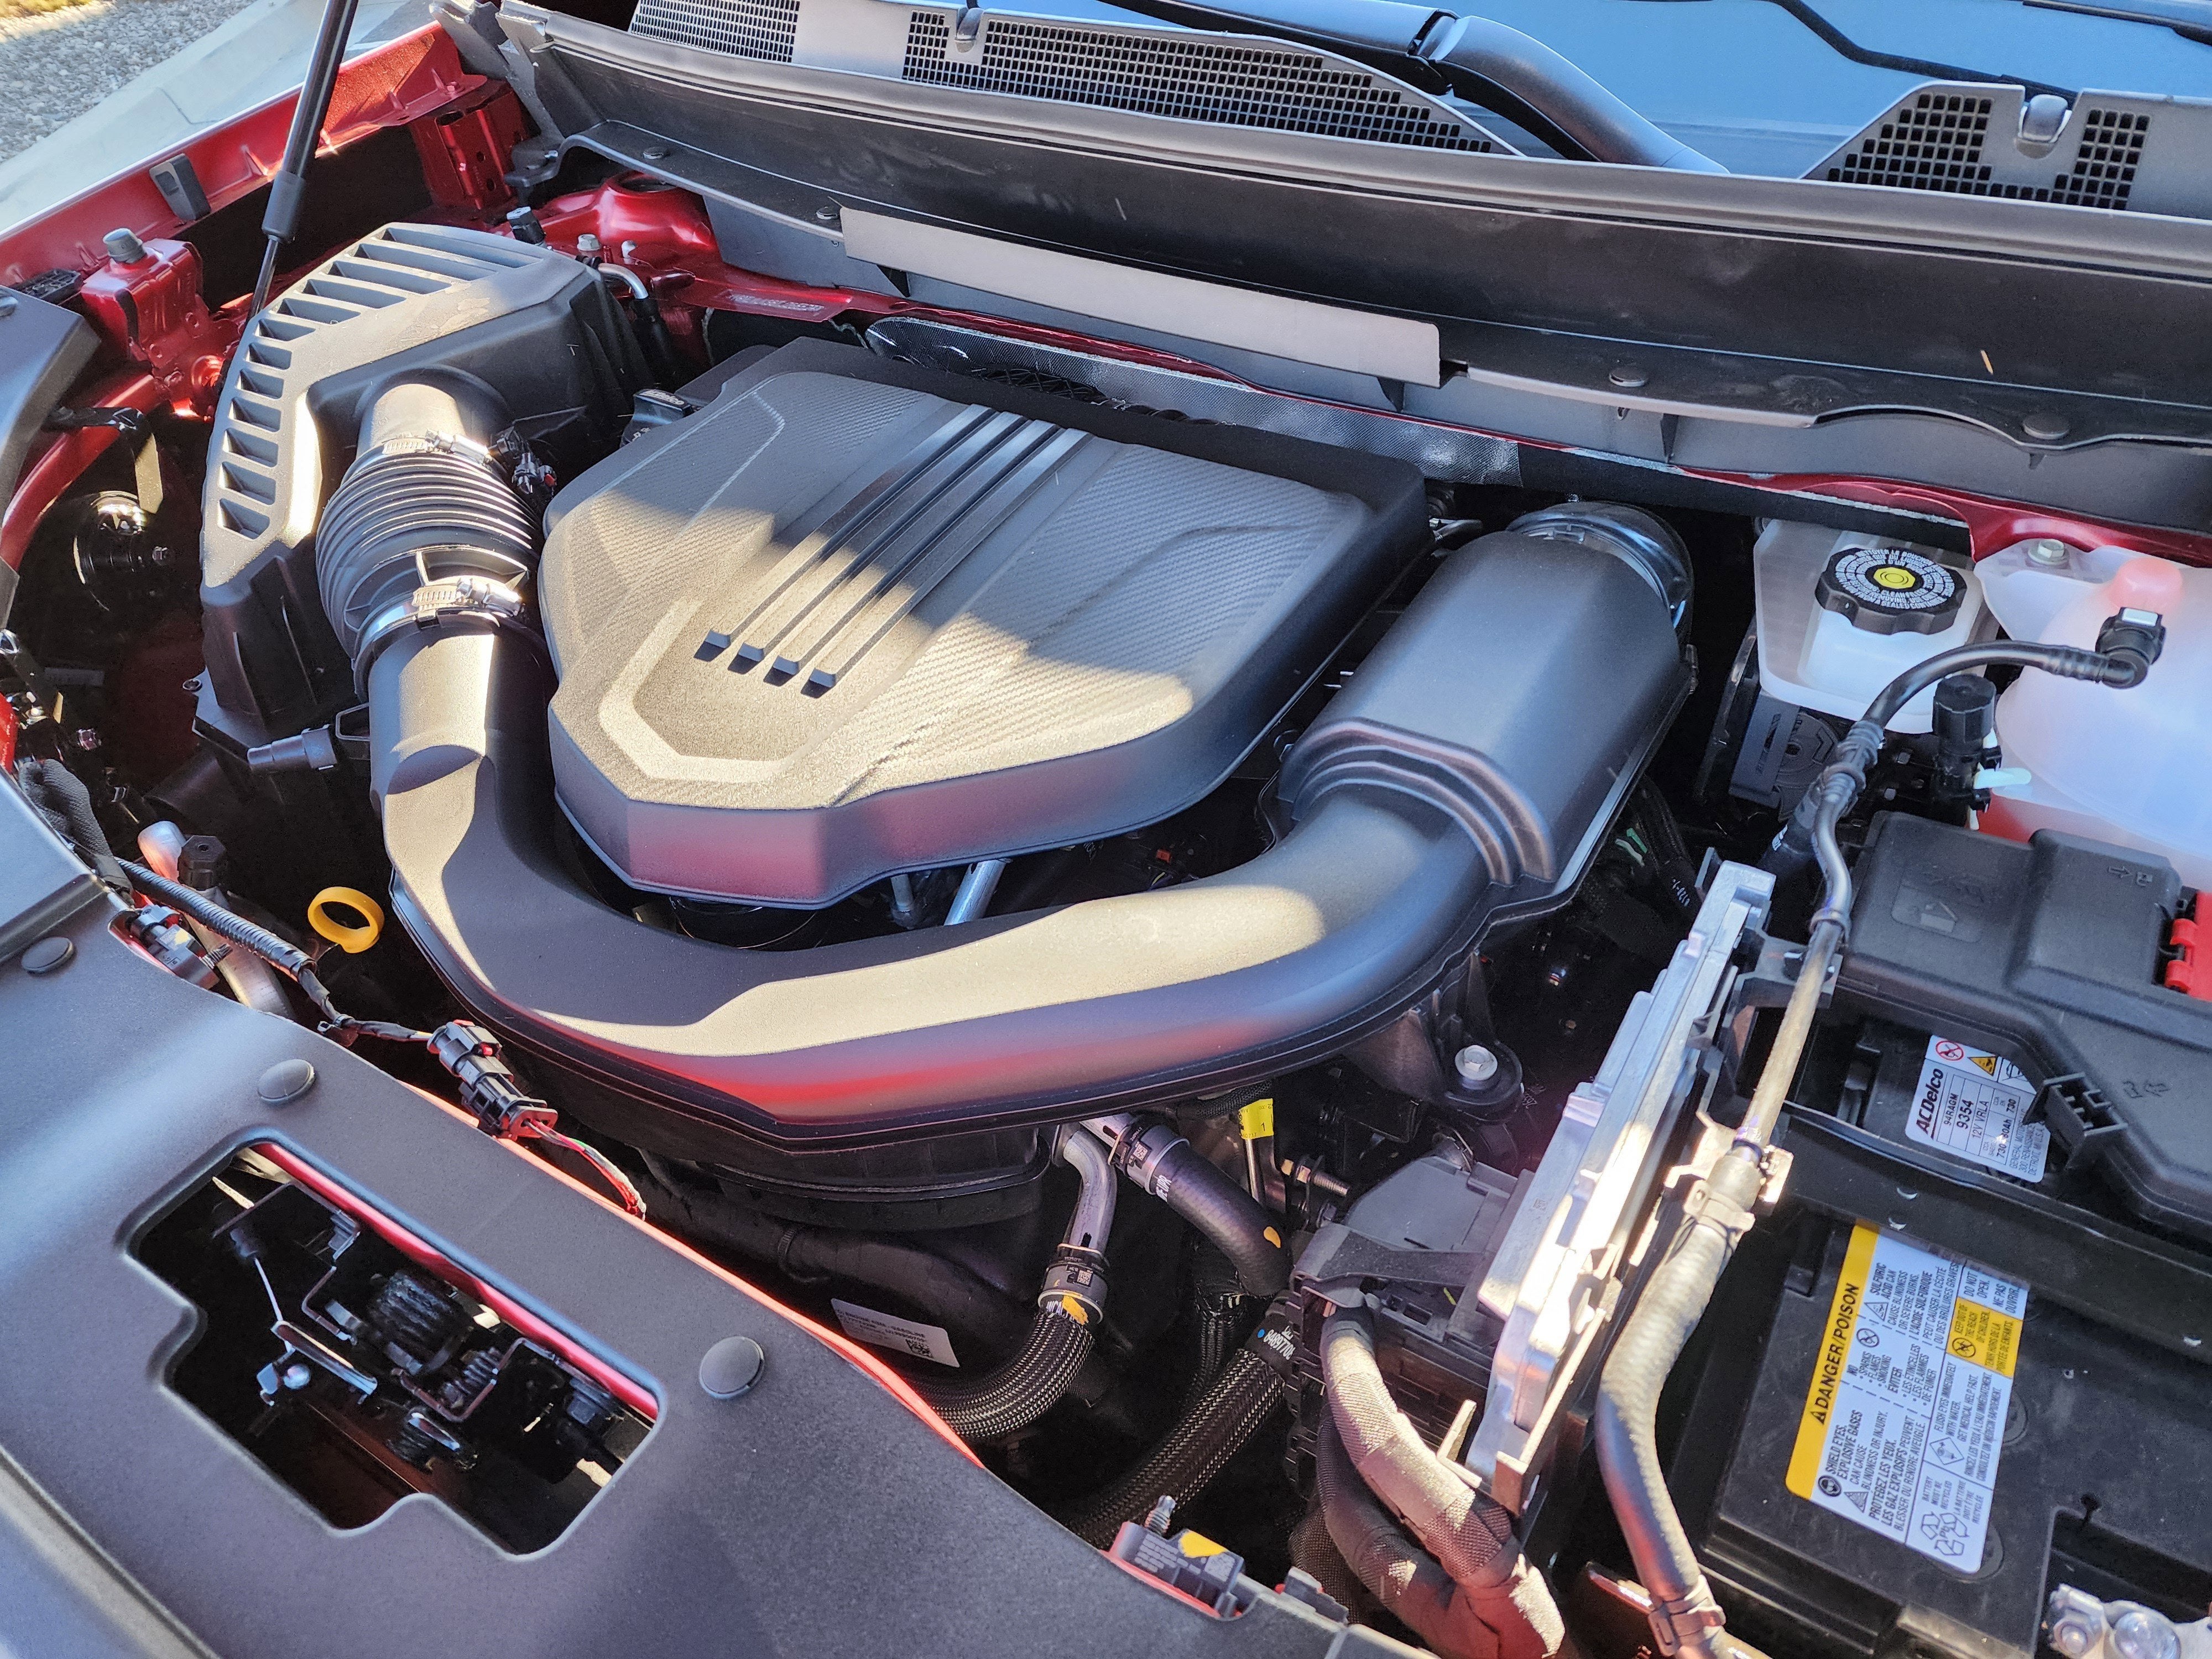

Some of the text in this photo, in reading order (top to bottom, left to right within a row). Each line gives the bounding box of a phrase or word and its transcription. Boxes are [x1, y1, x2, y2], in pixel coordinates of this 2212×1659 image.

[1914, 1066, 1944, 1135] ACDelco
[1943, 1092, 1958, 1125] 94RAGM
[2006, 1098, 2016, 1113] 730
[1955, 1098, 1974, 1130] 9354
[1971, 1099, 1989, 1140] 12V VRLA
[1996, 1142, 2007, 1159] 730
[2008, 1142, 2022, 1169] GENERAL
[2019, 1161, 2028, 1172] 300
[1869, 1261, 1886, 1296] SULFURIC
[1880, 1269, 1896, 1300] ACID CAN
[1963, 1271, 1978, 1297] DO NOT
[1976, 1277, 1990, 1298] OPEN.
[1887, 1269, 1908, 1326] CAUSE BLINDNESS
[1909, 1270, 1933, 1335] L'ACIDE SULFURIQUE
[1932, 1287, 1942, 1297] LA
[1992, 1283, 2006, 1307] NE PAS
[1900, 1294, 1914, 1320] SEVERE
[1926, 1297, 1939, 1323] CAUSER
[1957, 1310, 1966, 1321] OUT
[1898, 1319, 1908, 1330] OR
[1922, 1321, 1934, 1340] PEUT
[1936, 1321, 1947, 1334] DES
[1964, 1311, 1978, 1338] THE REACH
[1990, 1329, 1999, 1338] DE
[1991, 1322, 2001, 1331] LA
[1264, 1329, 1296, 1360] 84897706
[1814, 1282, 1859, 1410] DANGER/POISON
[1934, 1333, 1944, 1344] OU
[1987, 1337, 1998, 1353] HORS
[1846, 1364, 1859, 1376] NO
[1858, 1350, 1872, 1376] SPARKS
[1867, 1354, 1881, 1380] FLAMES
[1876, 1354, 1891, 1384] SMOKING
[1911, 1353, 1929, 1398] LES FLAMMES
[1901, 1380, 1912, 1394] LES
[1921, 1368, 1937, 1402] DE FUMER
[1934, 1361, 1956, 1432] FLUSH EYES IMMEDIATELY
[1957, 1373, 1978, 1442] GET MEDICAL HELP FAST.
[1945, 1420, 1957, 1437] WITH
[1969, 1431, 1981, 1447] YEUX
[1836, 1408, 1863, 1480] EXPLOSIVE GASES
[1861, 1408, 1888, 1491] BLINDNESS OR INJURY.
[1968, 1445, 1978, 1458] LES
[1981, 1441, 1991, 1452] UN
[1825, 1445, 1841, 1475] SHIELD
[1849, 1443, 1867, 1485] CAN CAUSE
[1881, 1415, 1914, 1527] LES GAZ EXPLOSIFS PEUVENT
[1964, 1455, 1976, 1477] RINCEZ
[1976, 1450, 1990, 1482] CONSULTEZ
[1865, 1436, 1896, 1521] PROTÉGEZ LES YEUX.
[1893, 1419, 1926, 1532] BLESSER OU RENDRE AVEUGLE.
